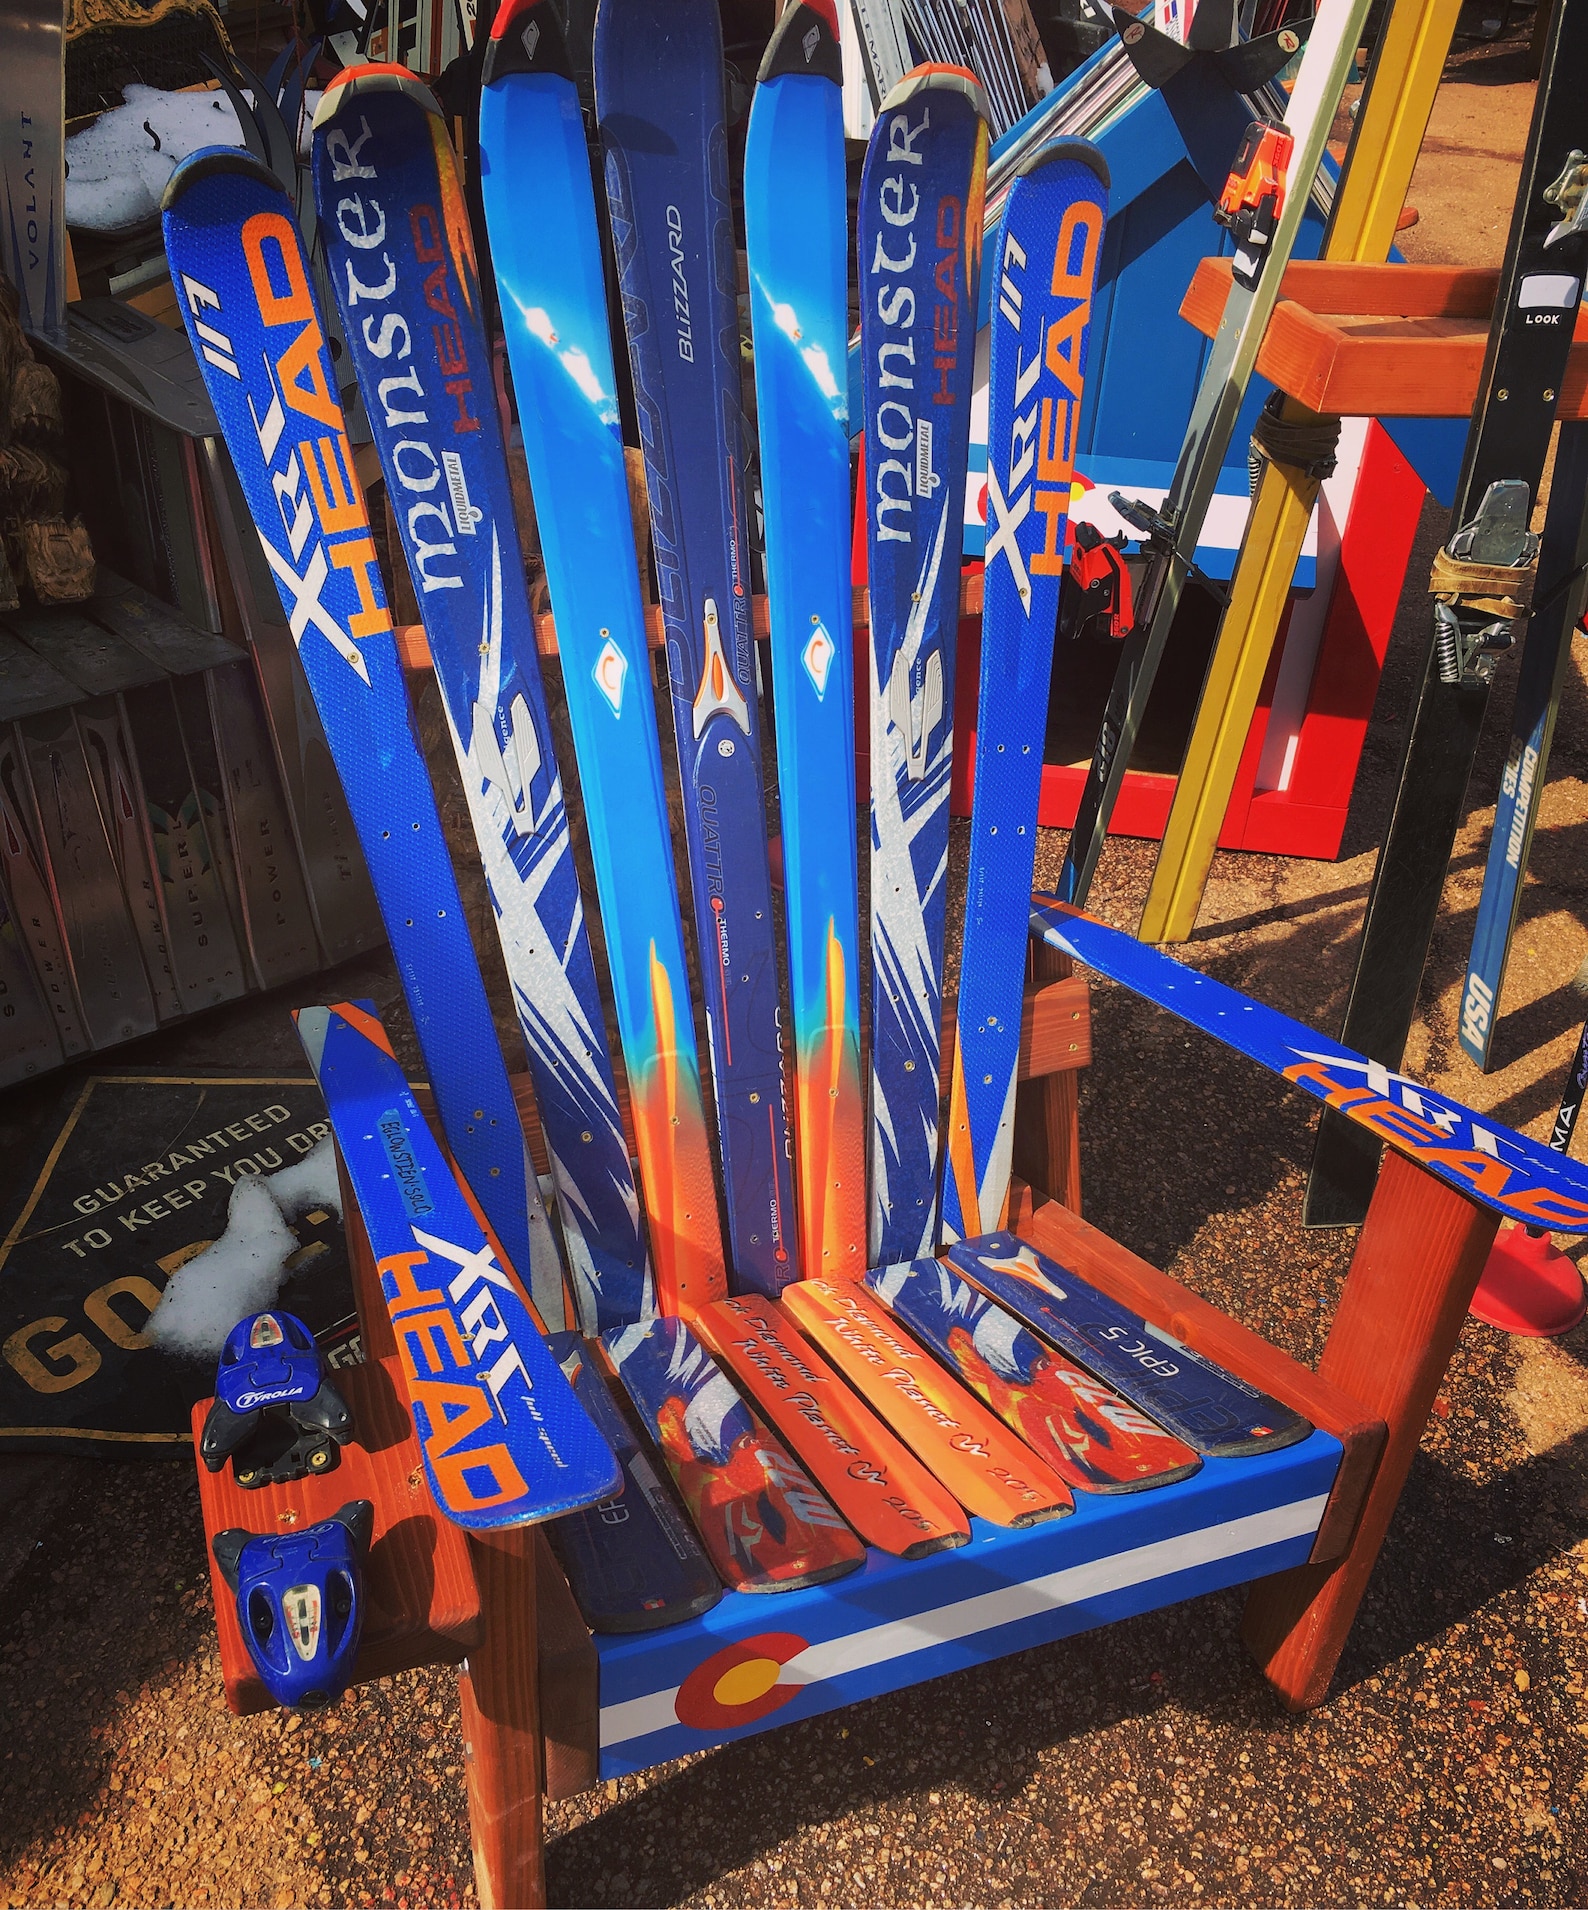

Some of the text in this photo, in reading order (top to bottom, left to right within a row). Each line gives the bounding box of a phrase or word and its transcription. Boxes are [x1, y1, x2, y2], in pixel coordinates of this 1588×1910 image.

[21, 111, 39, 269] VOLANT
[408, 203, 480, 434] HEAD
[934, 197, 962, 405] HEAD
[1525, 314, 1560, 325] LOOK
[240, 212, 393, 638] HEAD
[1030, 201, 1103, 576] HEAD
[447, 457, 471, 531] LIQUIDMETAL
[919, 424, 929, 493] LIQUIDMETAL
[1502, 734, 1524, 799] SERIES
[1506, 746, 1537, 870] COMPETITION
[260, 818, 285, 925] POWER
[699, 784, 730, 966] QUATTRO THERMO
[32, 917, 66, 1013] POWER
[143, 880, 172, 974] POWER
[1460, 972, 1494, 1051] USA
[61, 1118, 333, 1258] TO KEEP YOU DR
[72, 1104, 292, 1215] GUARANTEED
[745, 1318, 830, 1382] Diamond
[834, 1298, 924, 1360] Diamond
[1099, 1326, 1128, 1341] 5
[1119, 1340, 1179, 1377] EPIC
[236, 1387, 303, 1408] TYROLIA
[377, 1250, 530, 1512] HEAD
[537, 1427, 569, 1468] speed
